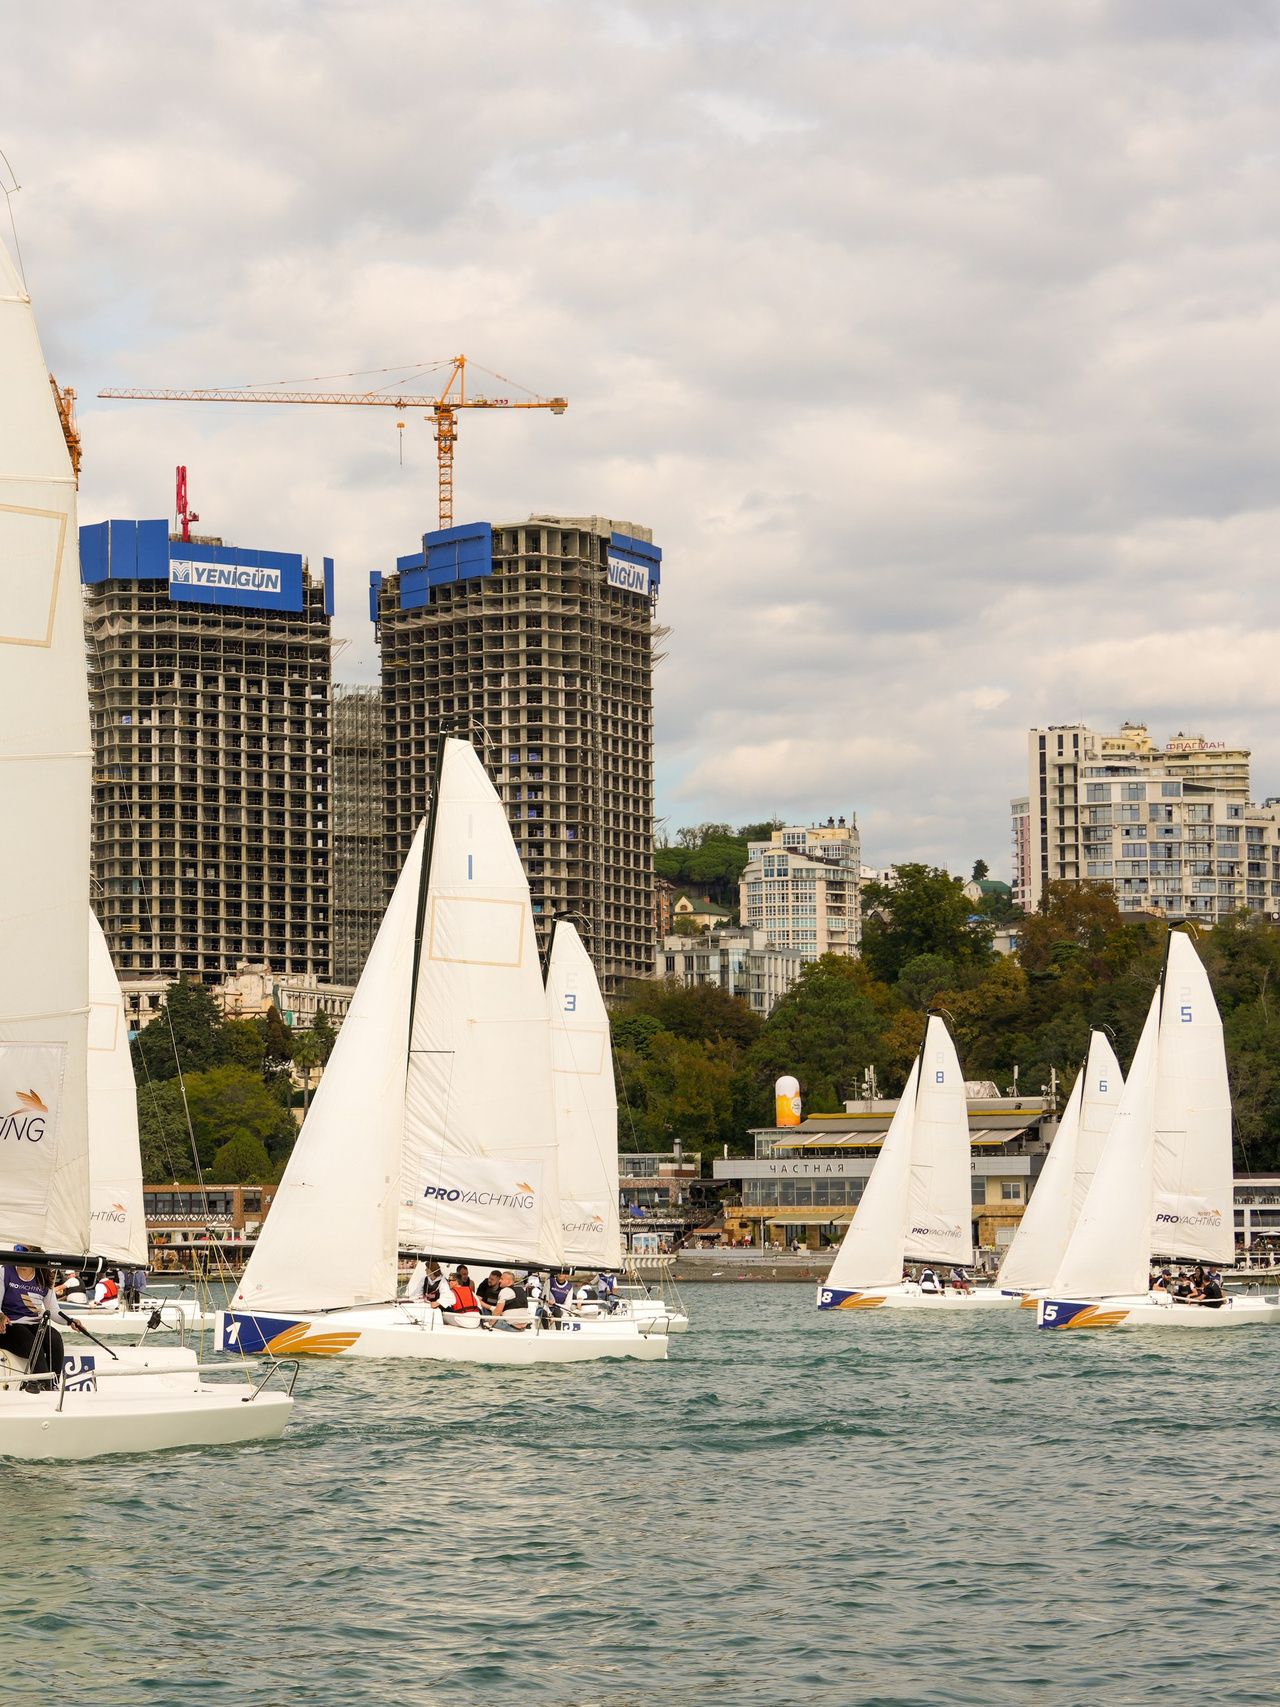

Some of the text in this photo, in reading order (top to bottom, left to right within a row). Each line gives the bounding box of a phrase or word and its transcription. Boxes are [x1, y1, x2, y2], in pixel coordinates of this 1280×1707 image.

[1166, 742, 1225, 750] ФЛАГМАН
[564, 994, 576, 1012] 3
[1181, 1006, 1192, 1022] 5
[936, 1071, 944, 1084] 8
[1099, 1080, 1108, 1092] 6
[769, 1164, 844, 1173] ЧАСТНАЯ
[424, 1186, 534, 1209] PROYACHTING
[90, 1211, 126, 1223] HTING
[1155, 1213, 1221, 1227] PROYACHTING
[911, 1227, 962, 1238] PROYACHTING
[821, 1291, 833, 1303] 8
[1043, 1305, 1058, 1321] 5
[225, 1321, 241, 1345] 1
